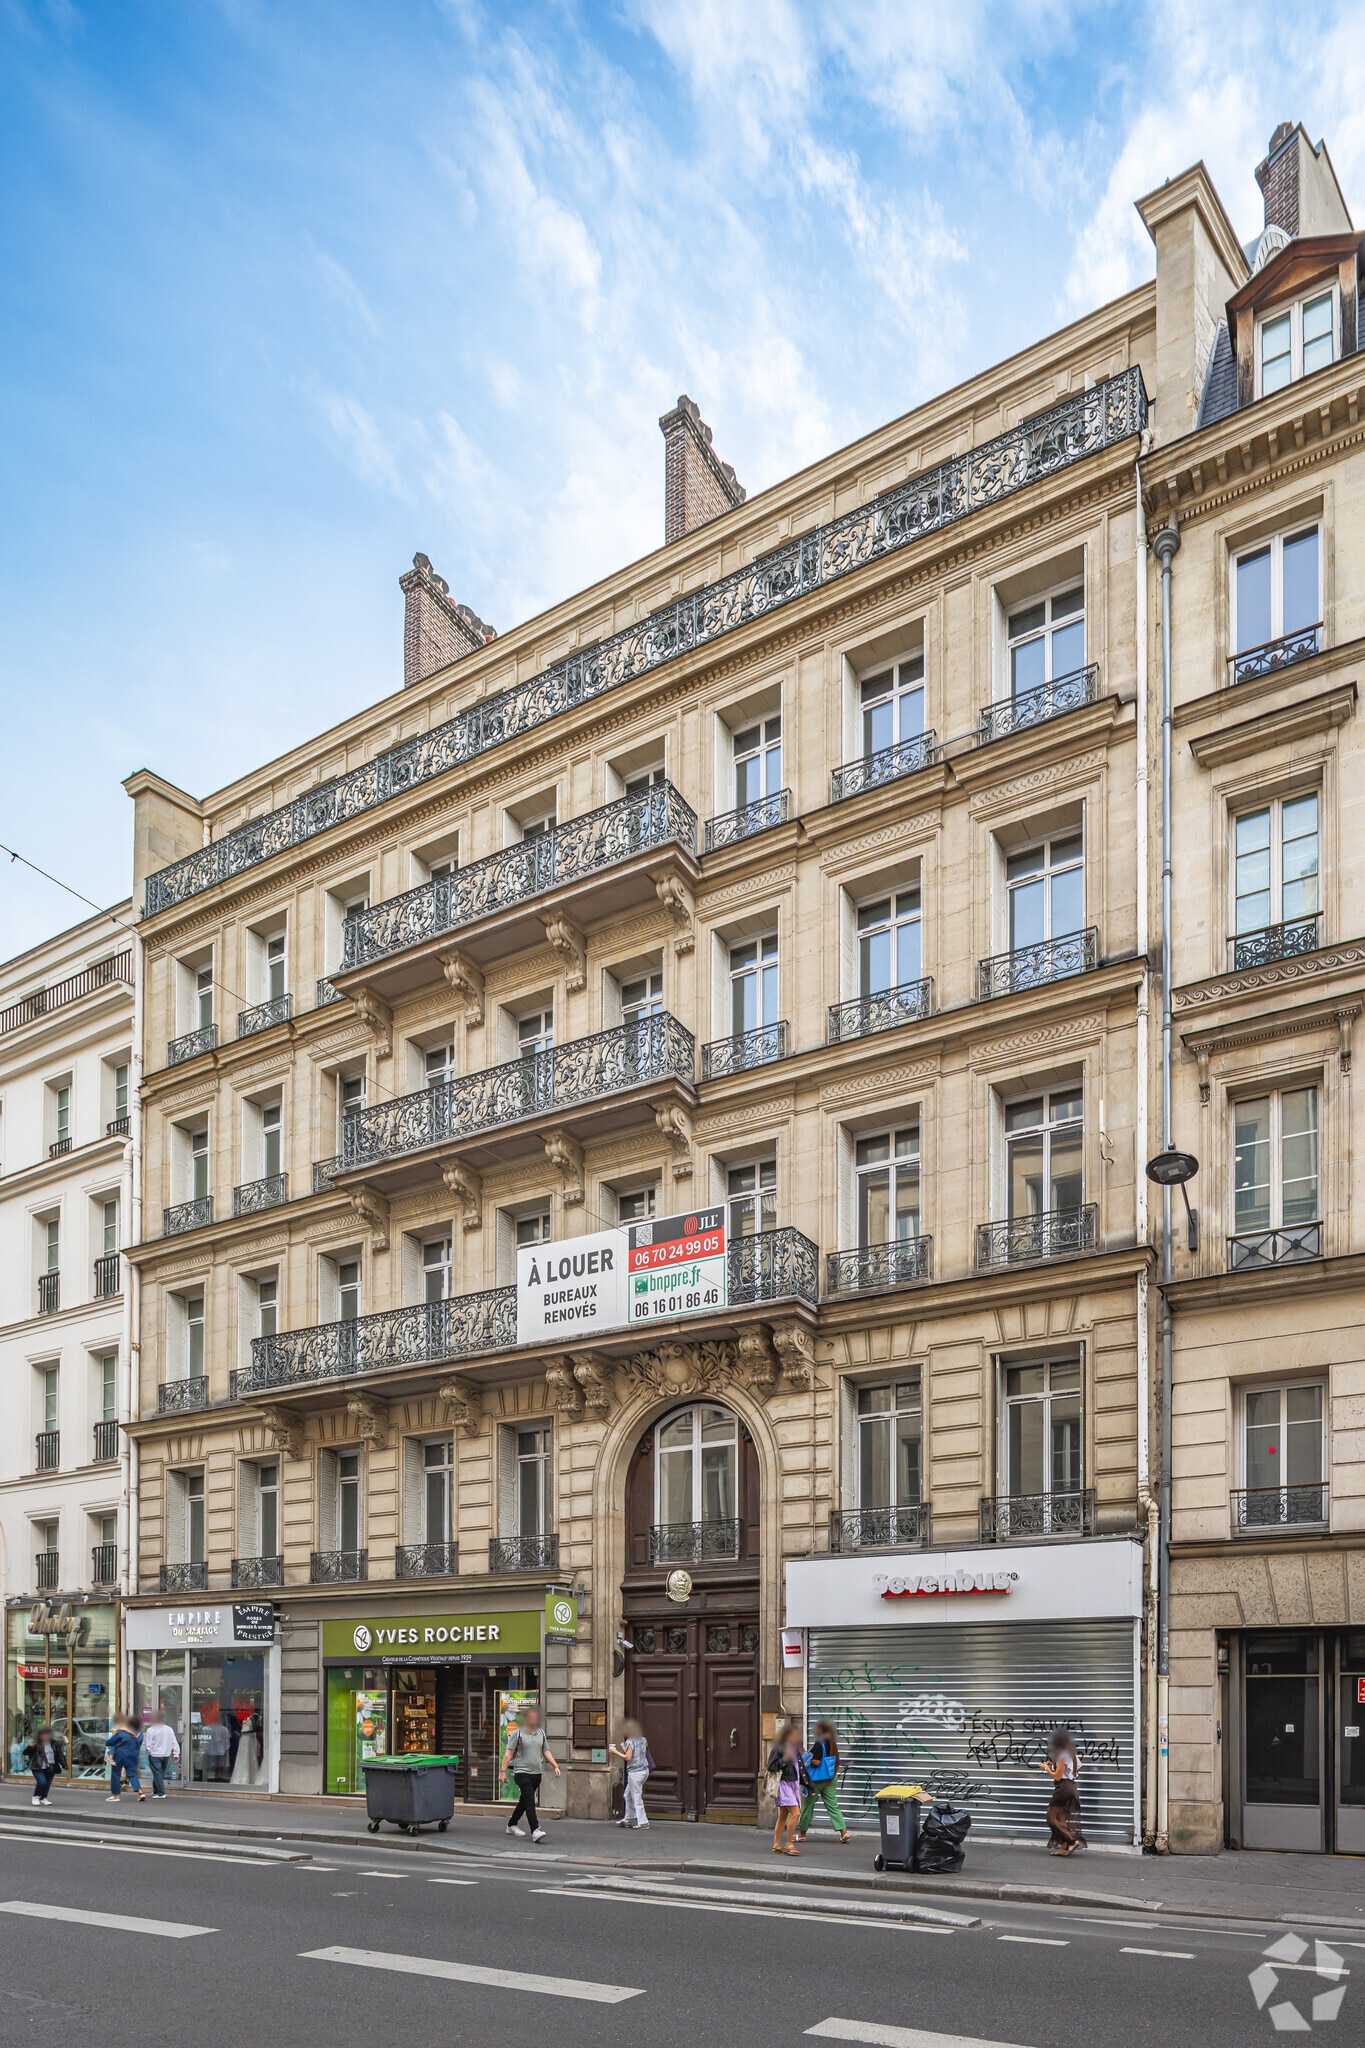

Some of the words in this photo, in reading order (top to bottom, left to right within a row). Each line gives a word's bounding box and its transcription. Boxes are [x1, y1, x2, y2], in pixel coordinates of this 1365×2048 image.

[635, 1251, 649, 1266] 06
[652, 1247, 667, 1262] 70
[669, 1244, 684, 1259] 24
[686, 1240, 701, 1255] 99
[703, 1236, 719, 1251] 05
[527, 1257, 541, 1287] À
[546, 1248, 614, 1283] LOUER
[649, 1265, 701, 1293] bnppre.fr
[543, 1284, 597, 1306] BUREAUX
[635, 1302, 649, 1317] 06
[653, 1299, 666, 1314] 16
[669, 1295, 682, 1311] 01
[686, 1292, 701, 1308] 86
[703, 1289, 718, 1305] 46
[544, 1301, 597, 1325] RENOVÉS
[168, 1611, 221, 1626] EMPIRE
[238, 1606, 270, 1617] EMPIRE
[172, 1627, 183, 1636] DU
[185, 1626, 218, 1636] MARIAGE
[237, 1629, 273, 1640] PRESTIGE
[375, 1628, 419, 1644] YVES
[424, 1625, 500, 1643] ROCHER
[955, 1710, 1014, 1734] JÉSUS
